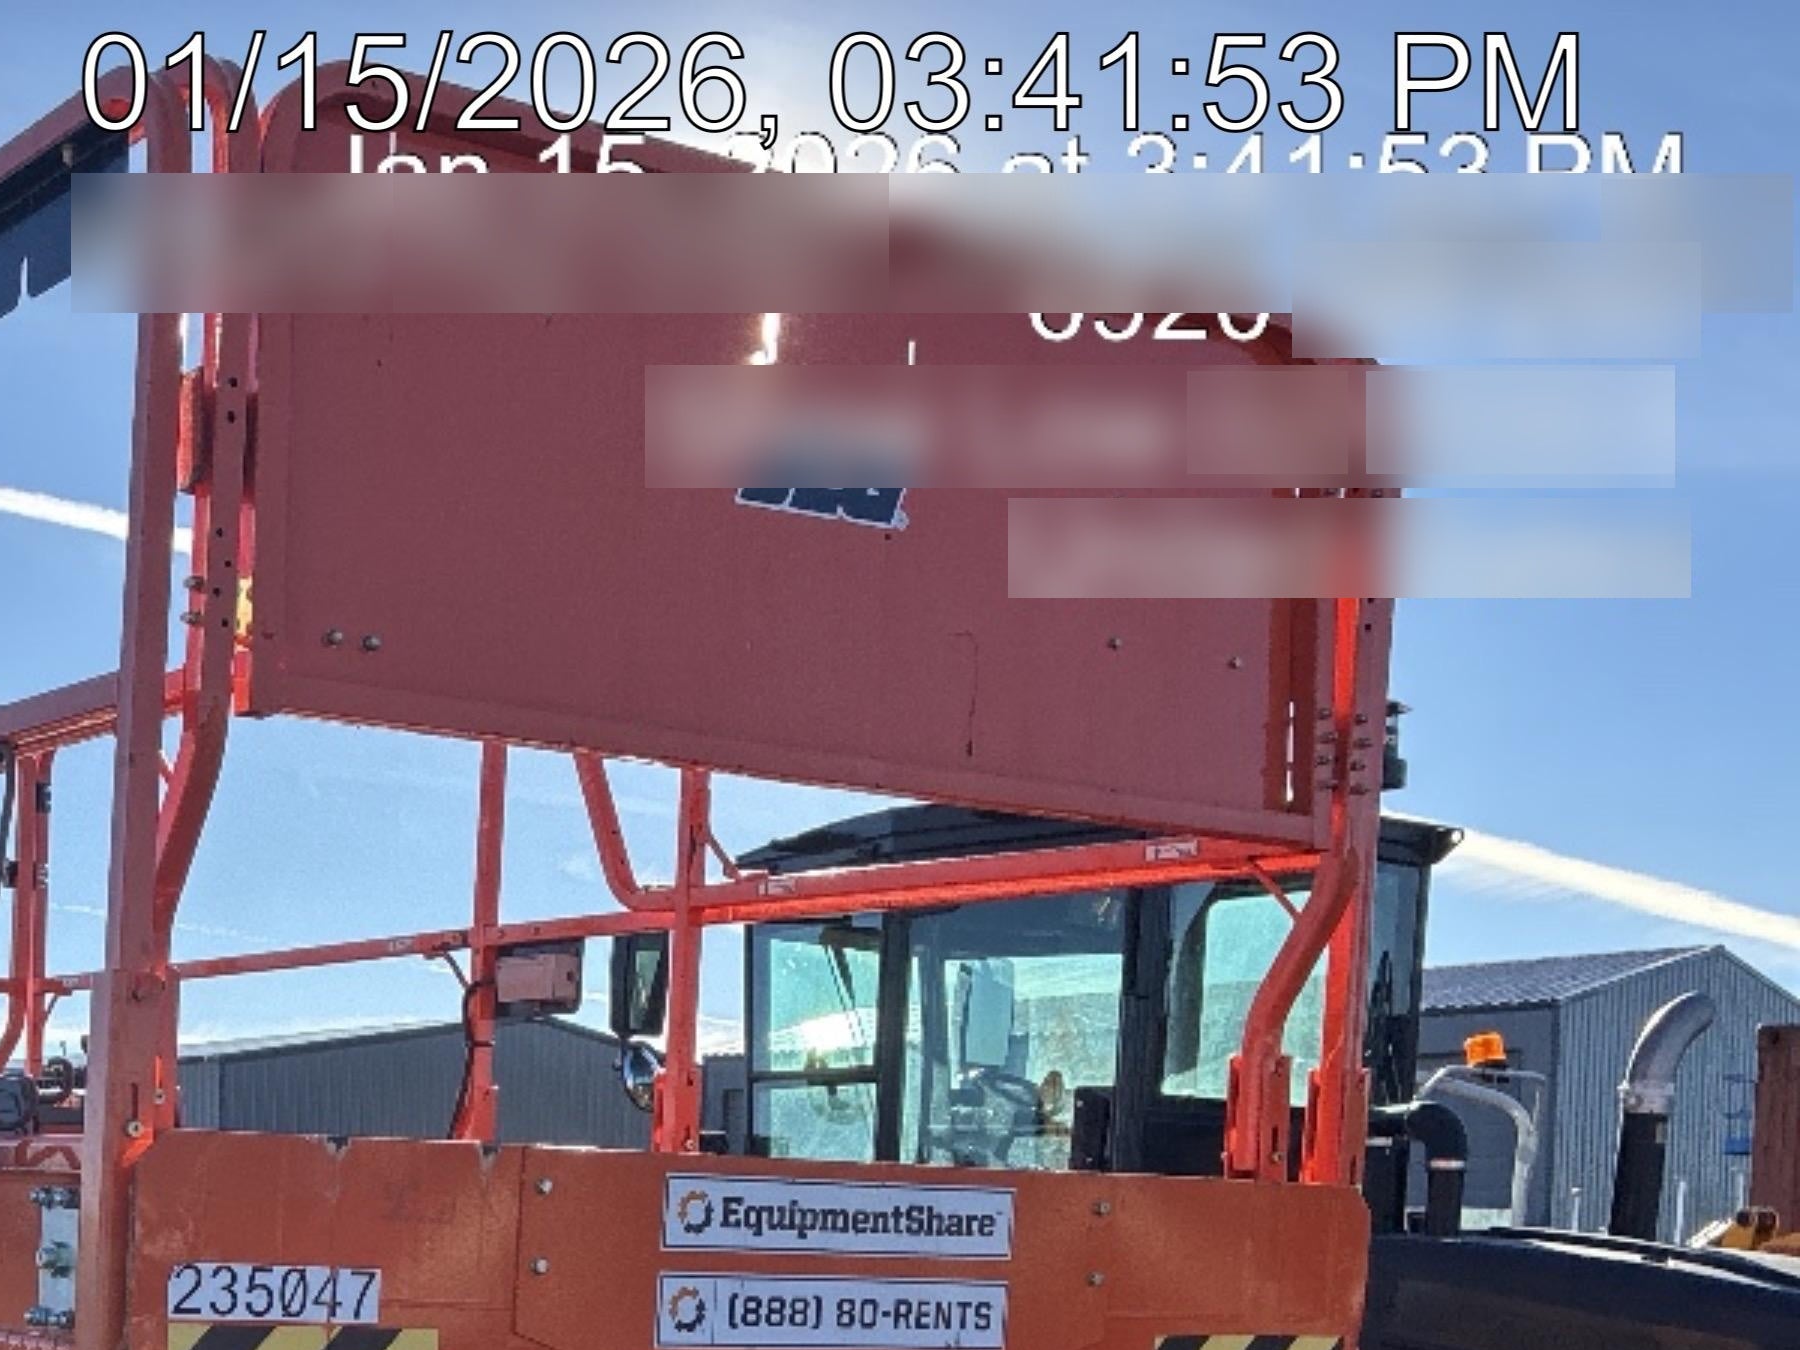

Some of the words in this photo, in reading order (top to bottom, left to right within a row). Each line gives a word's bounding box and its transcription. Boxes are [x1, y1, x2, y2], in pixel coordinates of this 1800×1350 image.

[720, 1196, 997, 1239] EquipmentShare
[171, 1264, 376, 1320] 235047
[728, 1293, 822, 1329] (888)
[836, 1299, 992, 1331] 80-RENTS
